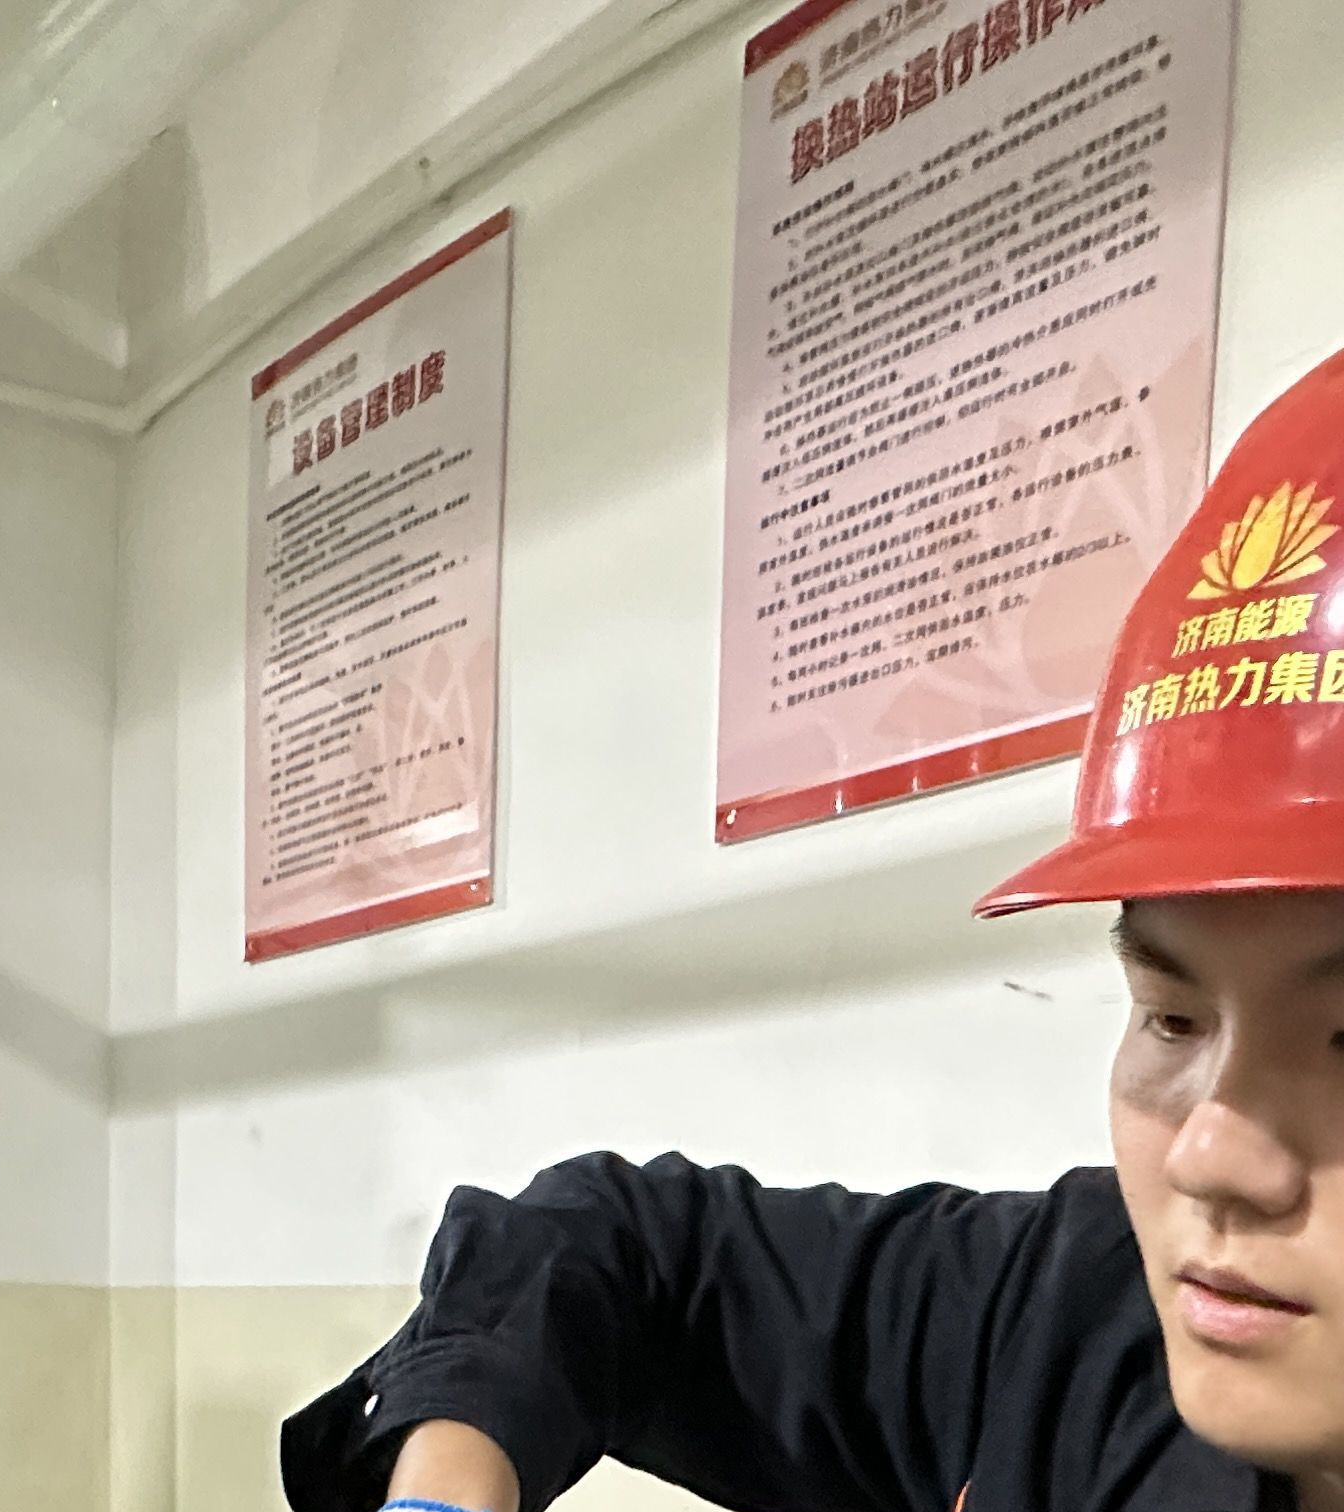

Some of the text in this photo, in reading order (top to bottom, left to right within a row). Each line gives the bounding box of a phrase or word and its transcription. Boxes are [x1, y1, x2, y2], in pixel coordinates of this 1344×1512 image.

[292, 350, 446, 476] 设备管理制度
[1171, 593, 1320, 659] 济南能源
